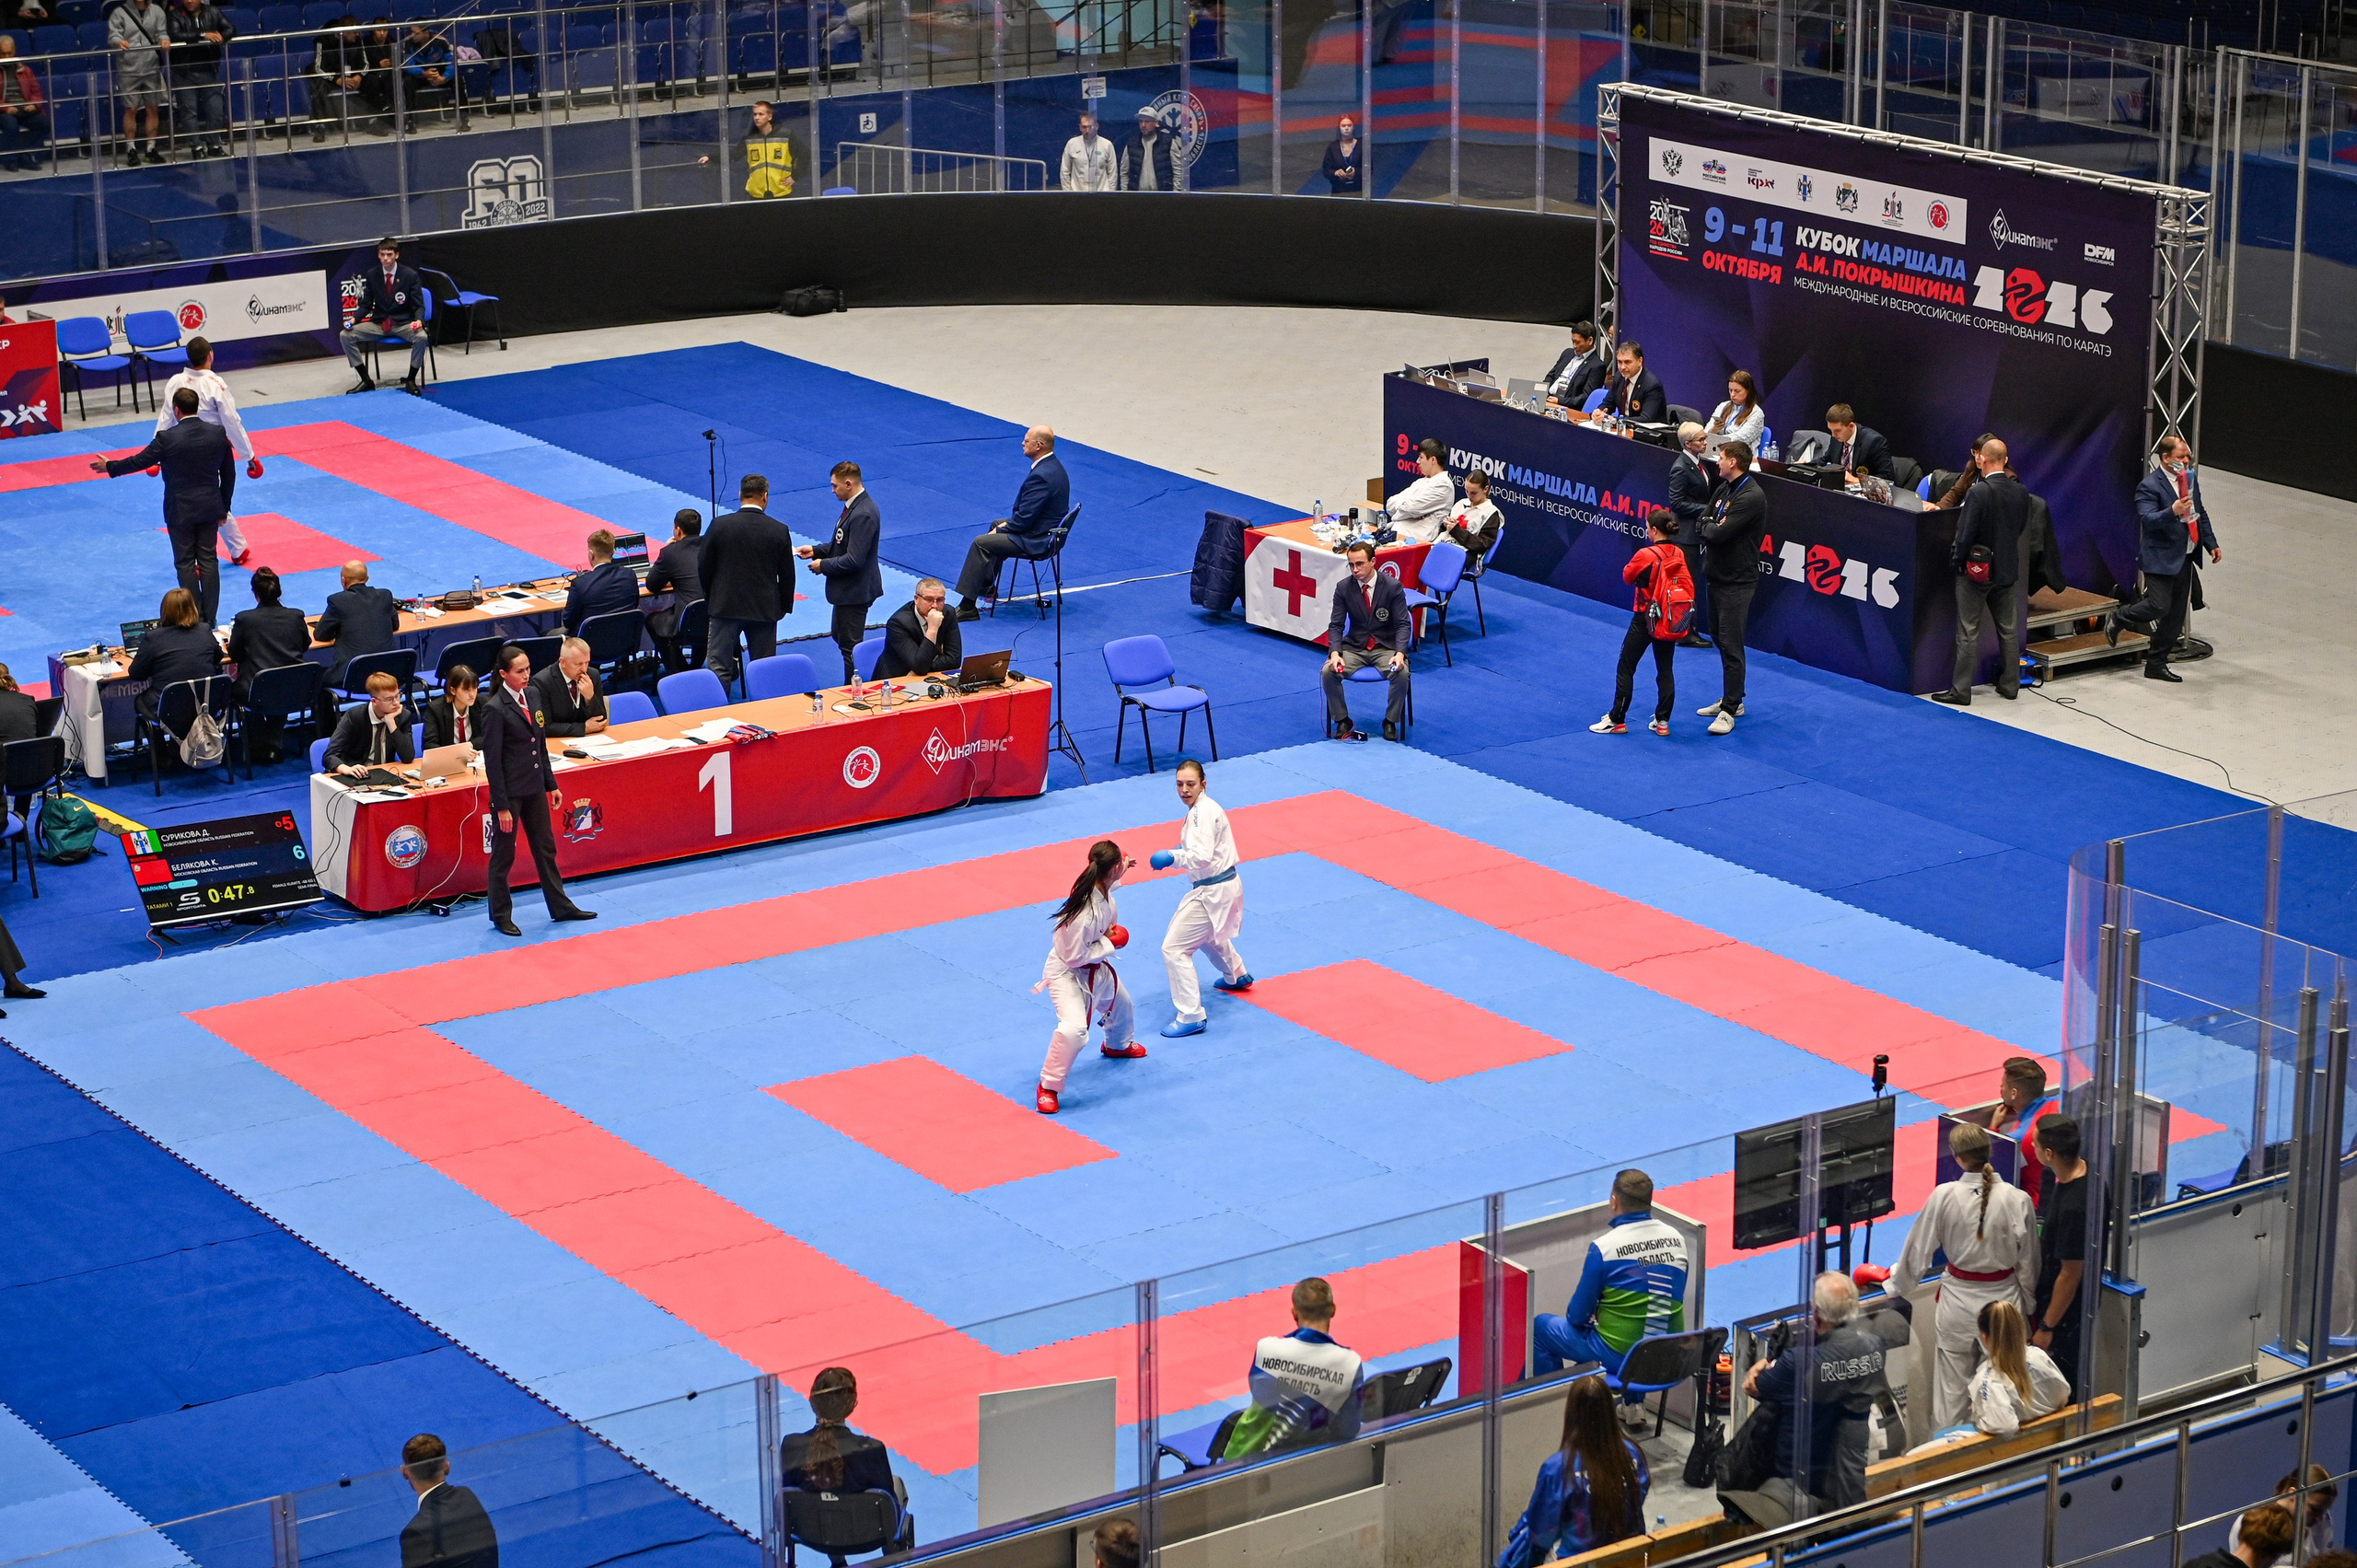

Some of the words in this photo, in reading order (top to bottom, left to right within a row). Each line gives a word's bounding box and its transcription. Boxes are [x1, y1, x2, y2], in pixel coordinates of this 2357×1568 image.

[525, 202, 546, 216] 2022
[1650, 204, 1664, 222] 20
[1650, 219, 1664, 236] 26
[1704, 206, 1725, 243] 9
[1751, 217, 1783, 257] 11
[1795, 226, 1860, 258] КУБОК
[1861, 241, 1967, 281] МАРШАЛА
[2084, 243, 2115, 261] DFM
[1702, 250, 1782, 285] ОКТЯБРЯ
[1794, 251, 1829, 276] А.И.
[1832, 260, 1965, 306] ПОКРЫШКИНА
[341, 283, 356, 296] 20
[342, 296, 357, 308] 26
[1794, 276, 1879, 307] МЕЖДУНАРОДНЫЕ
[1880, 296, 1888, 308] И
[1889, 297, 1971, 327] ВСЕРОССИЙСКИЕ
[1973, 317, 2054, 345] СОРЕВНОВАНИЯ
[2056, 334, 2073, 349] ПО
[2074, 339, 2112, 357] КАРАТЭ
[1398, 434, 1409, 455] 9
[1449, 447, 1506, 480] КУБОК
[1507, 463, 1597, 506] МАРШАЛА
[1600, 490, 1634, 517] А.И.
[1537, 497, 1544, 510] И
[1546, 500, 1629, 534] ВСЕРОССИЙСКИЕ
[698, 750, 733, 837] 1
[160, 830, 201, 842] СУРИКОВА
[202, 829, 211, 838] Д.
[292, 844, 306, 860] 6
[171, 859, 209, 872] БЕЛЯКОВА
[211, 858, 219, 866] К.
[140, 884, 168, 893] WARNING
[1616, 1237, 1681, 1259] НОВОСИБИРСКАЯ
[1637, 1251, 1675, 1268] ОБЛАСТЬ
[1261, 1357, 1344, 1386] НОВОСИБИРСКАЯ
[1820, 1351, 1884, 1382] RUSSIA
[1276, 1376, 1320, 1396] ОБЛАСТЬ
